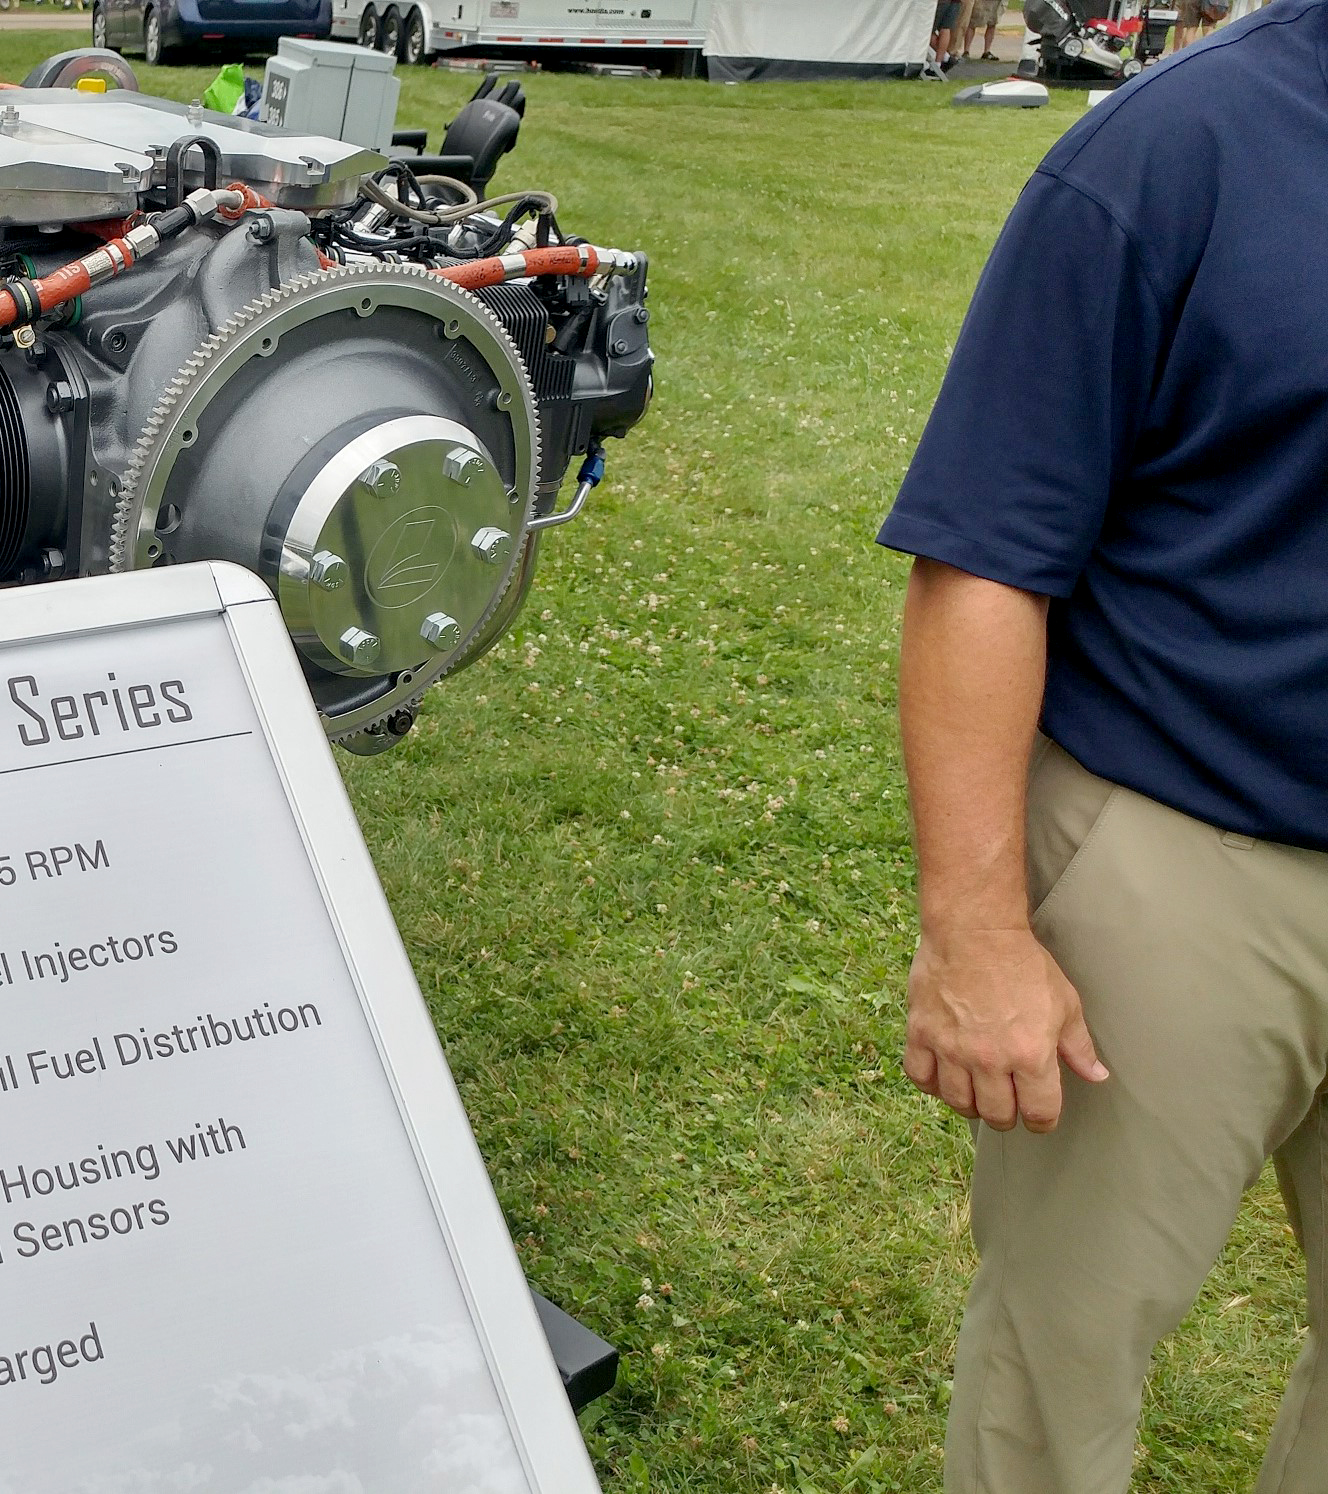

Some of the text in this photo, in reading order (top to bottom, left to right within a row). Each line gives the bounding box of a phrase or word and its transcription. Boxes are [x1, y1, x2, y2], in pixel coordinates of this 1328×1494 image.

[6, 671, 195, 747] Series
[24, 839, 111, 882] RPM
[21, 930, 179, 984] Injectors
[26, 1036, 107, 1085] Fuel
[113, 999, 322, 1067] Distribution
[165, 1117, 247, 1164] with
[12, 1198, 170, 1258] Sensors
